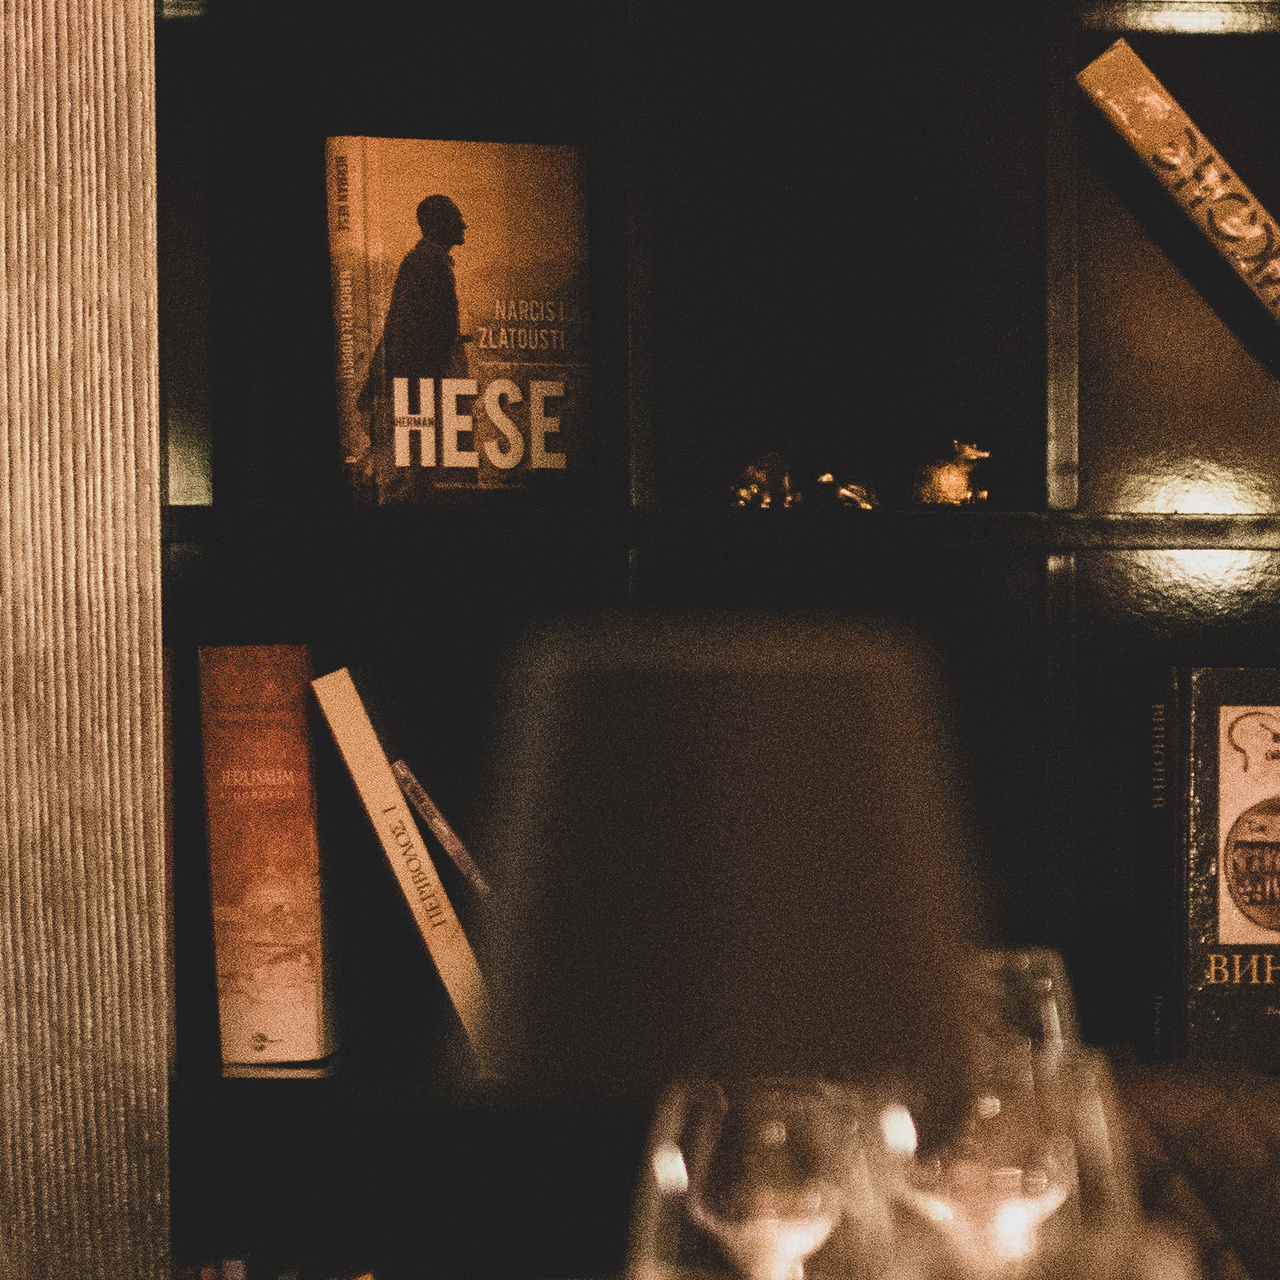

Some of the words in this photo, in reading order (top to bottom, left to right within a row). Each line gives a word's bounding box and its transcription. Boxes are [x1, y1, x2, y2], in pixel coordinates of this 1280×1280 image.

[494, 299, 556, 322] NARCIS
[477, 326, 565, 350] ZLATOUSTI
[393, 376, 567, 469] HESE
[395, 416, 435, 428] HERMAN
